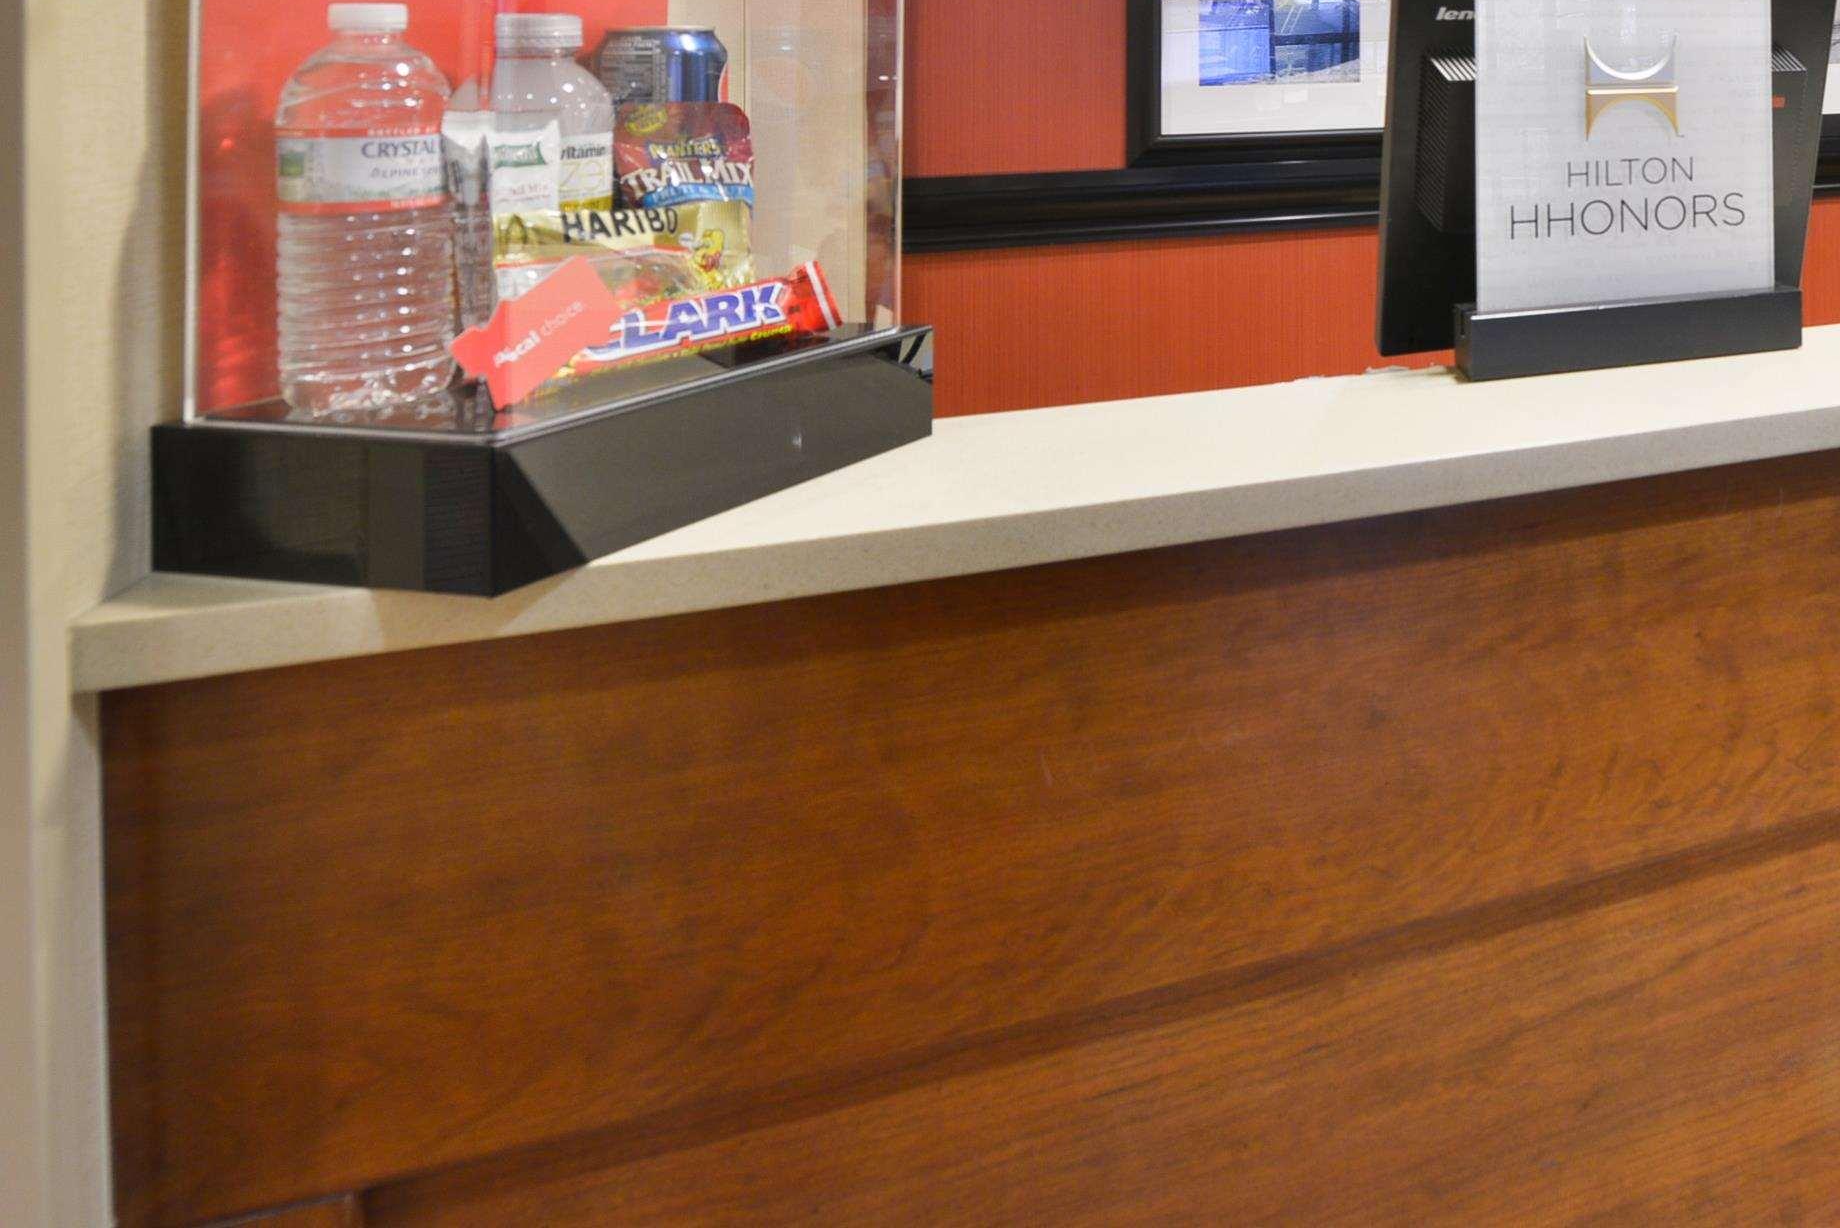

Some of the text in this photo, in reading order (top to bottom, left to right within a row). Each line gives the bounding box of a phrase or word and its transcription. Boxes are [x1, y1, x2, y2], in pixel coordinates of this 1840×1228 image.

[620, 158, 704, 200] TRAIL
[1567, 156, 1694, 188] HILTON
[559, 205, 678, 243] HARIBO
[1510, 192, 1746, 240] HHONORS
